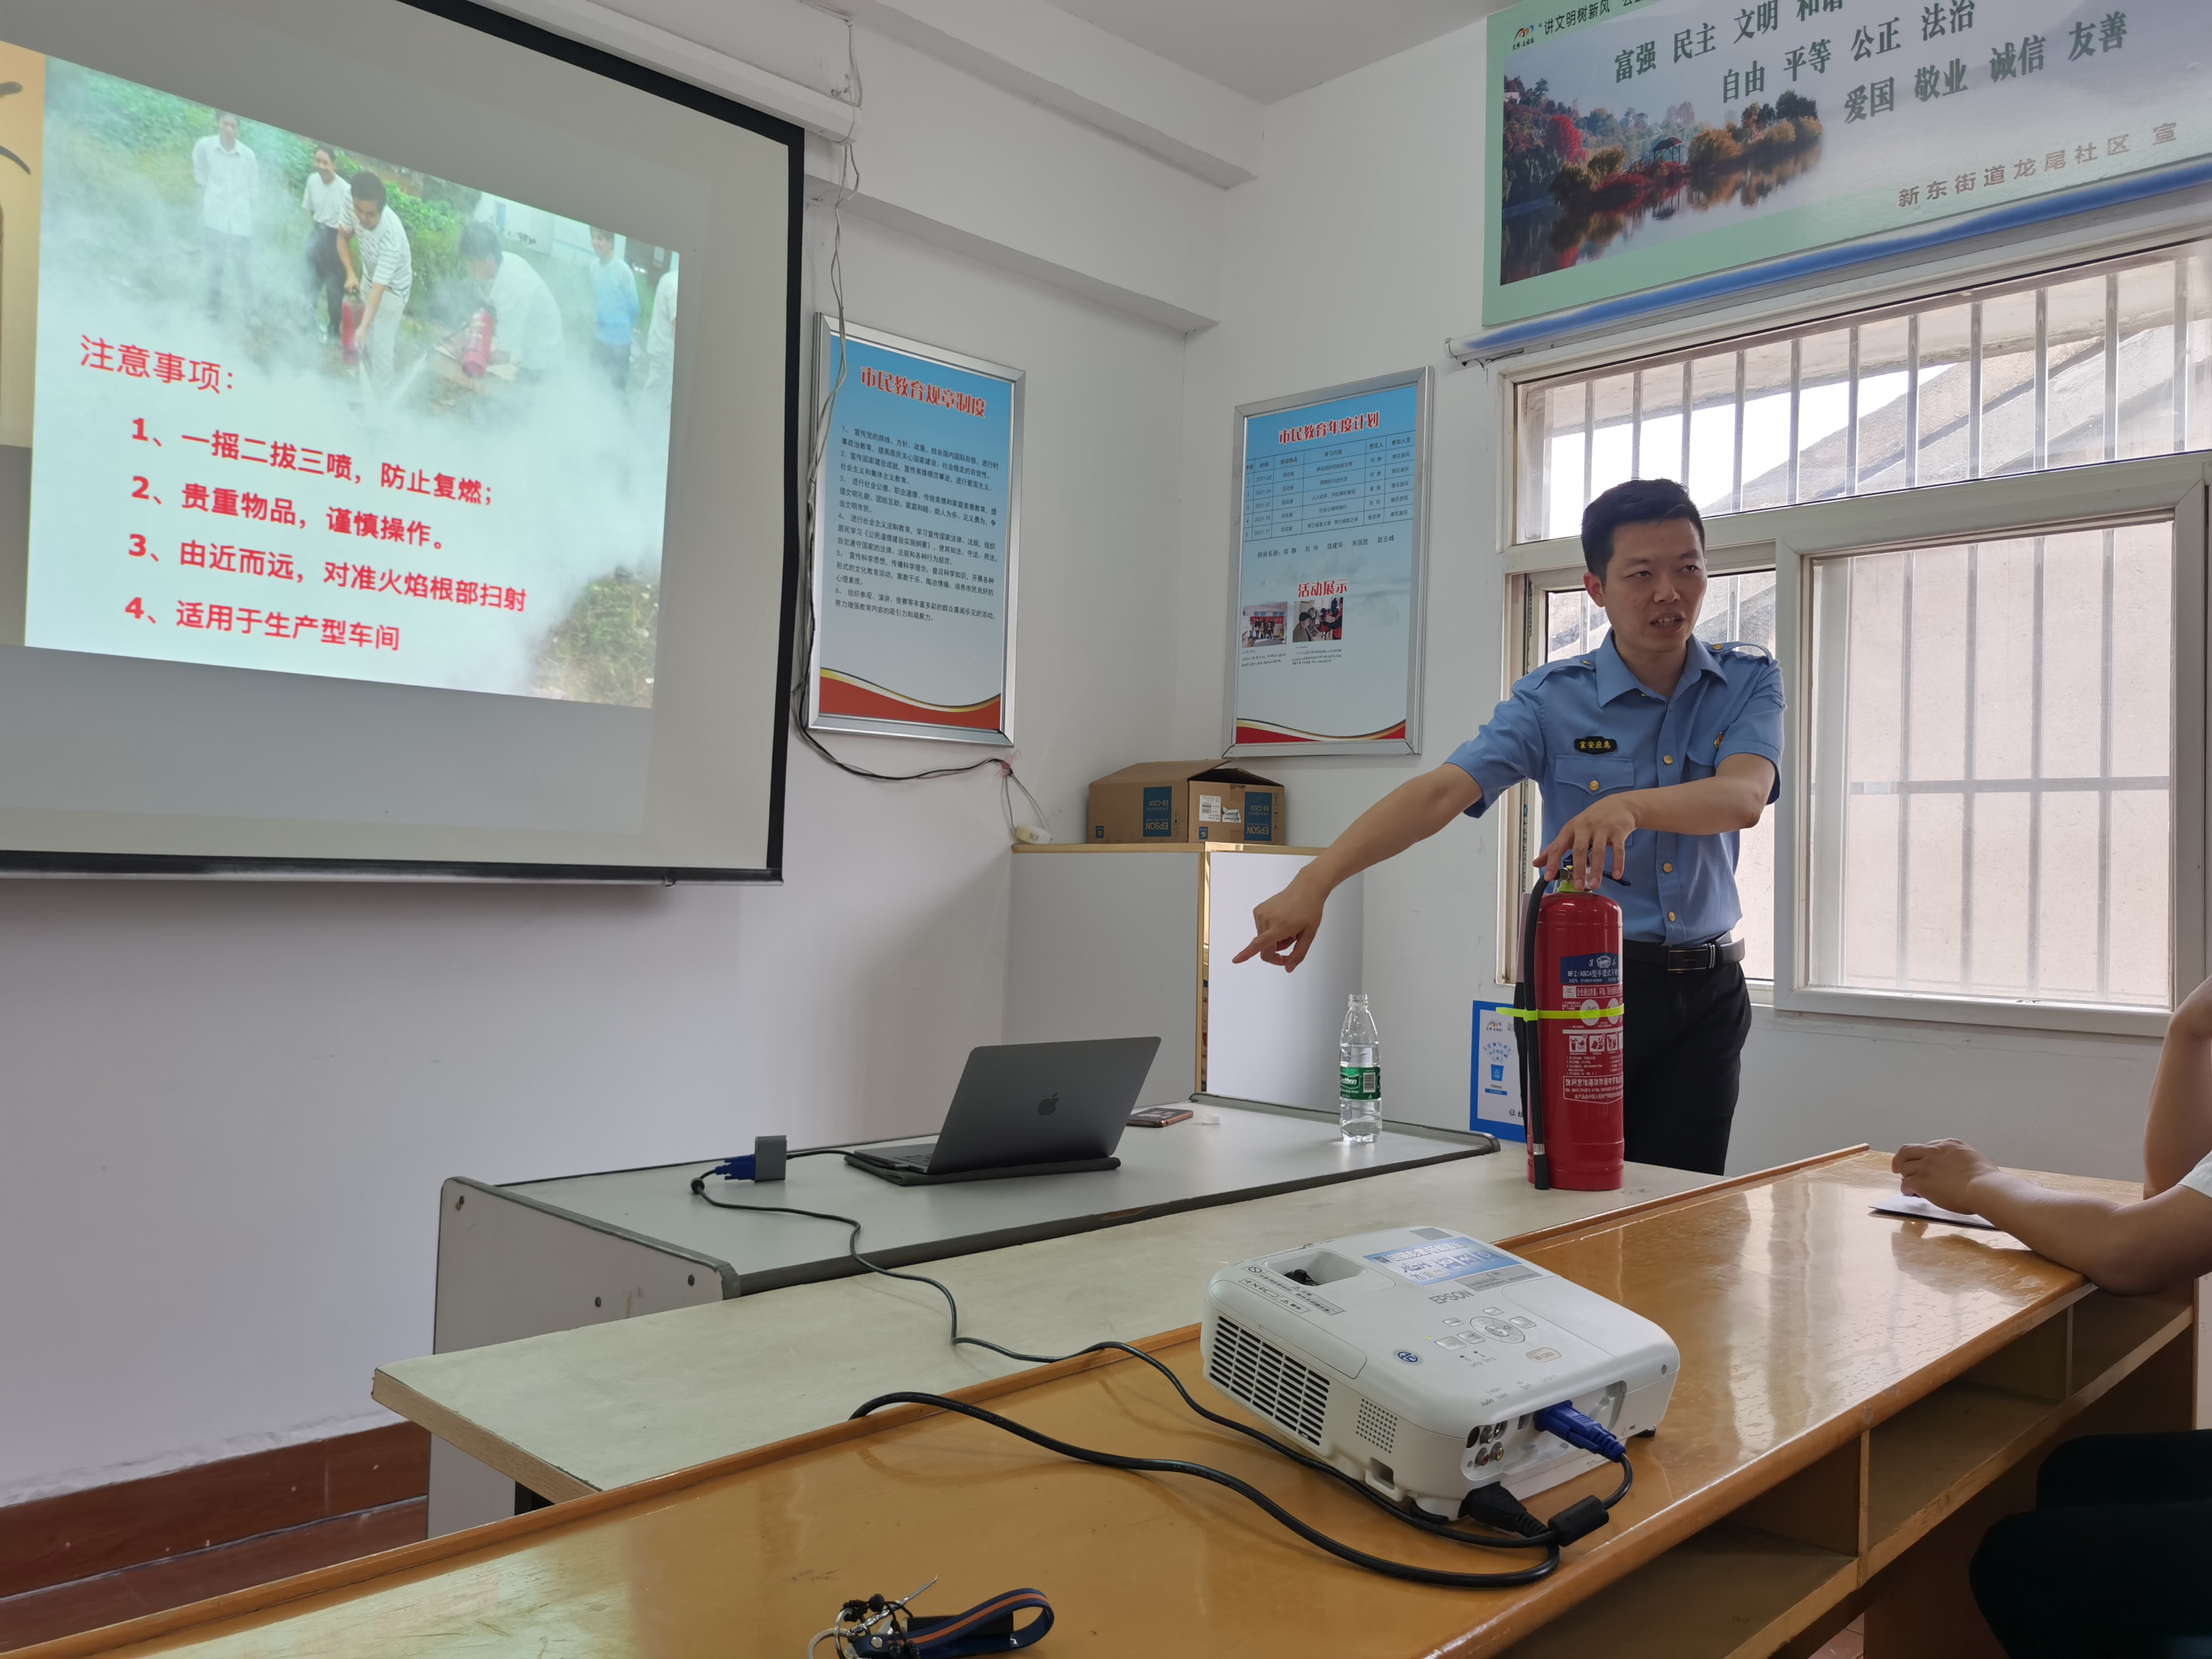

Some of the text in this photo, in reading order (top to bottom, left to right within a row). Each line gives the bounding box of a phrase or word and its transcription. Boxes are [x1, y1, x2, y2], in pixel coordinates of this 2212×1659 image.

[1614, 41, 1656, 83] 富强
[1673, 23, 1717, 63] 民主
[1733, 0, 1778, 44] 文明
[1723, 0, 1975, 104] 自由 平等 公正 法治
[1844, 11, 2128, 124] 爱国 敬业 诚信 友善
[1898, 122, 2177, 207] 新东街道龙尾社区 宣
[860, 366, 987, 418] 市民教育规章制度
[1278, 411, 1379, 445] 市民教育年度计划
[1324, 448, 1342, 458] 学习内容
[1369, 441, 1383, 450] 责任人
[1391, 436, 1410, 446] 参加人员
[1298, 578, 1348, 598] 活动展示
[1247, 826, 1269, 834] EPSON
[1428, 1289, 1475, 1304] EPSON
[1480, 1398, 1494, 1407] Audio
